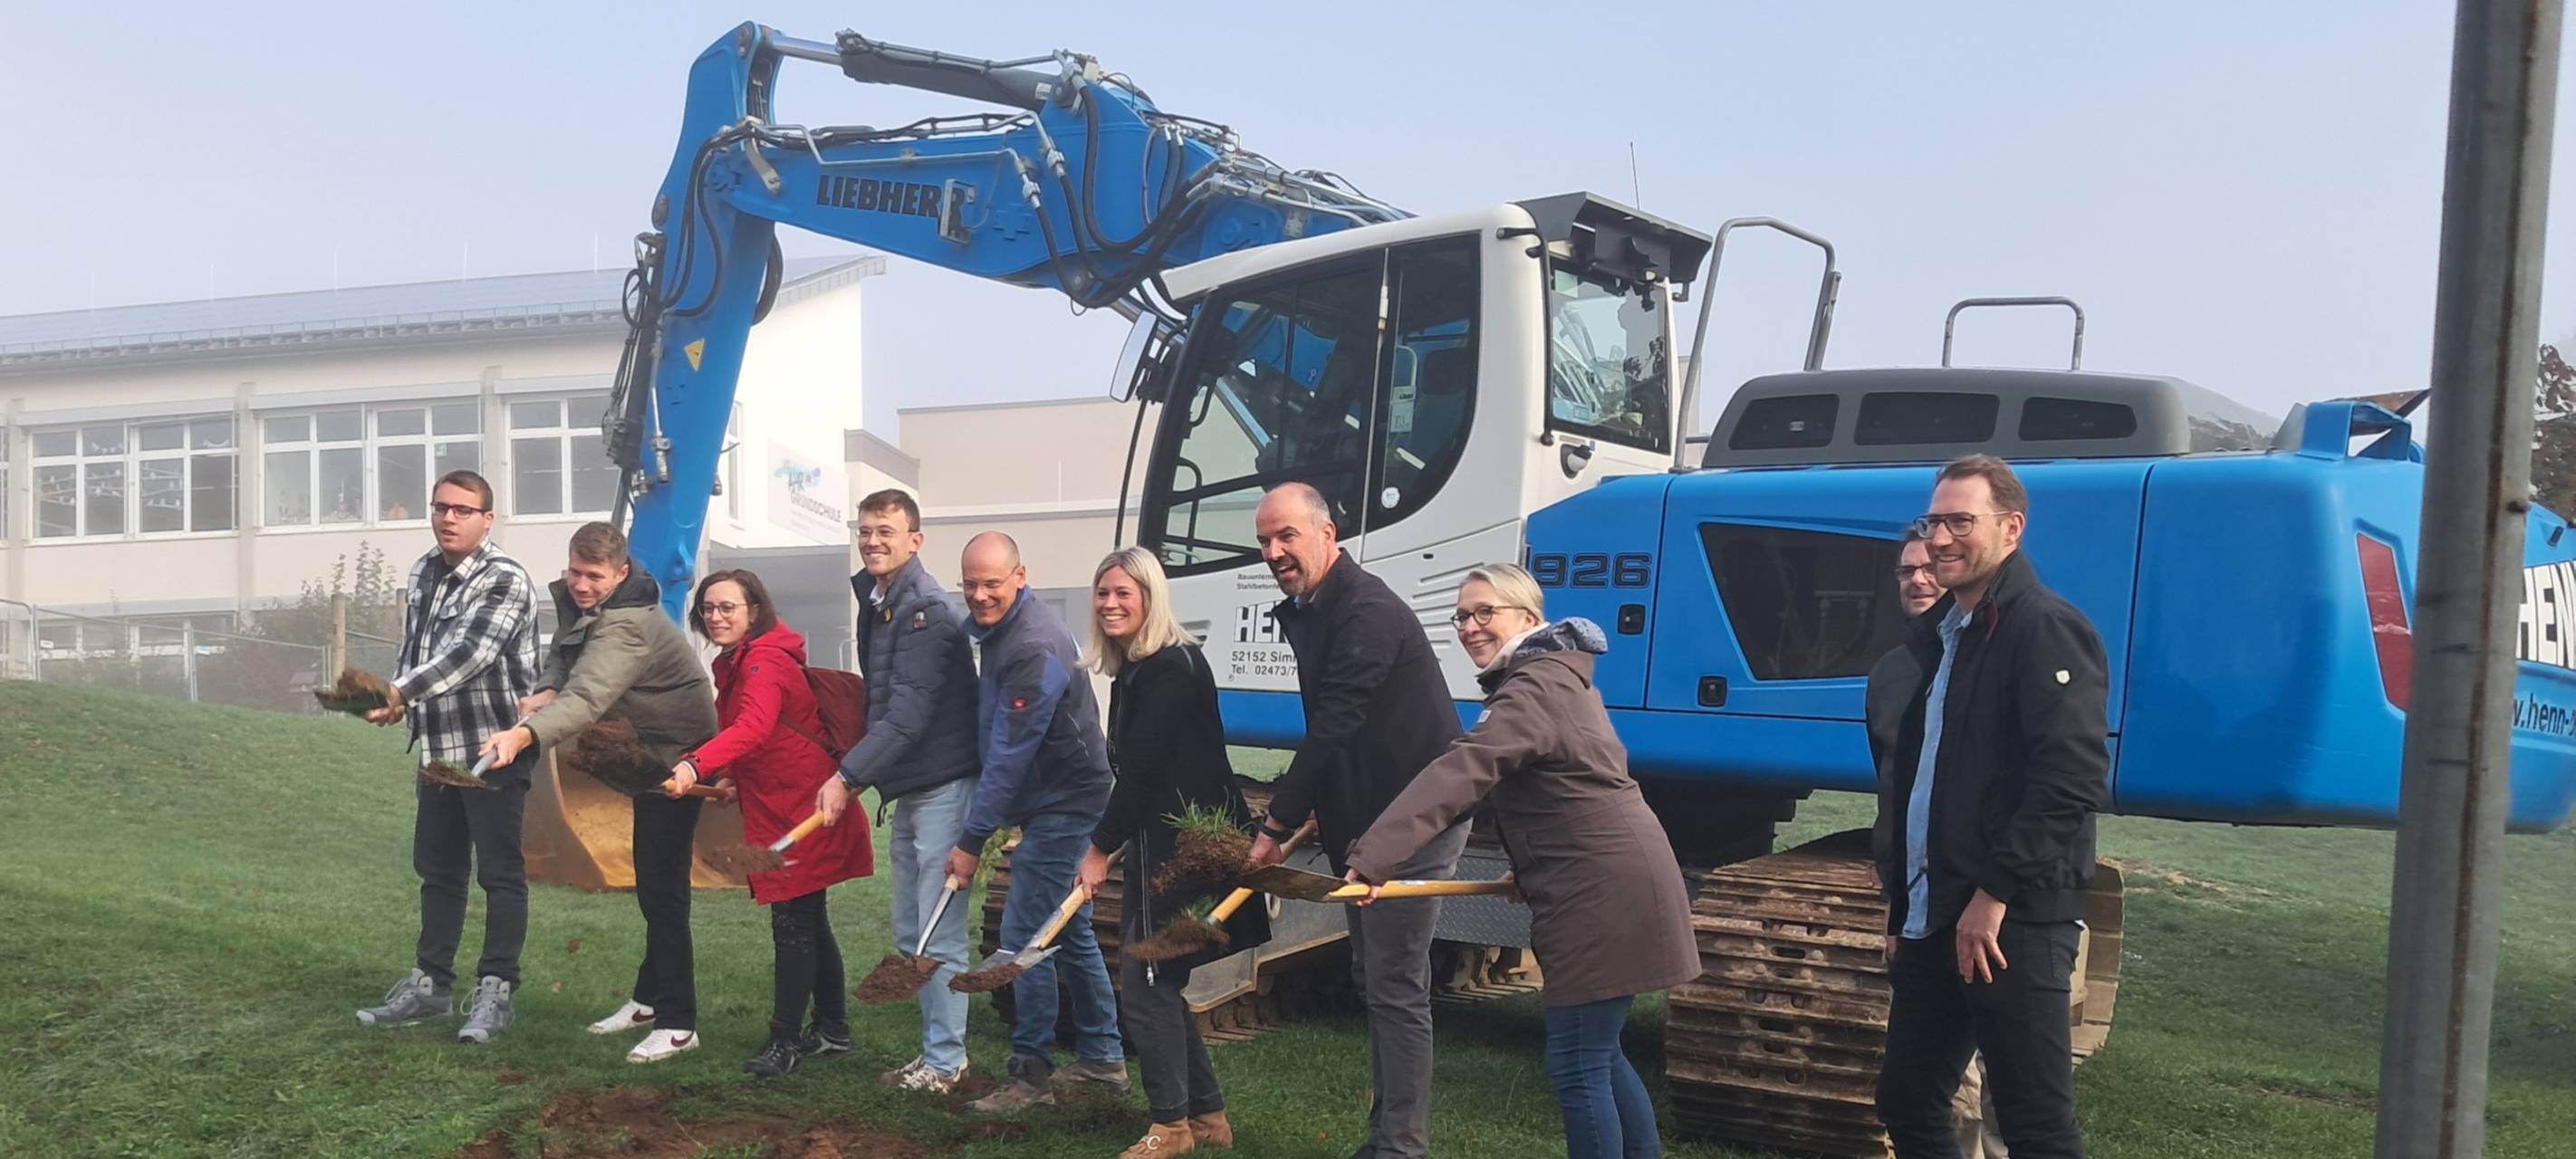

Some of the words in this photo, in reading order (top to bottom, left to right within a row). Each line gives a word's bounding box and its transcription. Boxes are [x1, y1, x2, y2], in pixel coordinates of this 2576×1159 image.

[818, 175, 966, 221] LIEBHERR
[1532, 551, 1653, 589] 926
[1232, 651, 1266, 662] 52152
[1232, 665, 1248, 675] Tel.
[1255, 665, 1296, 677] 02473/7
